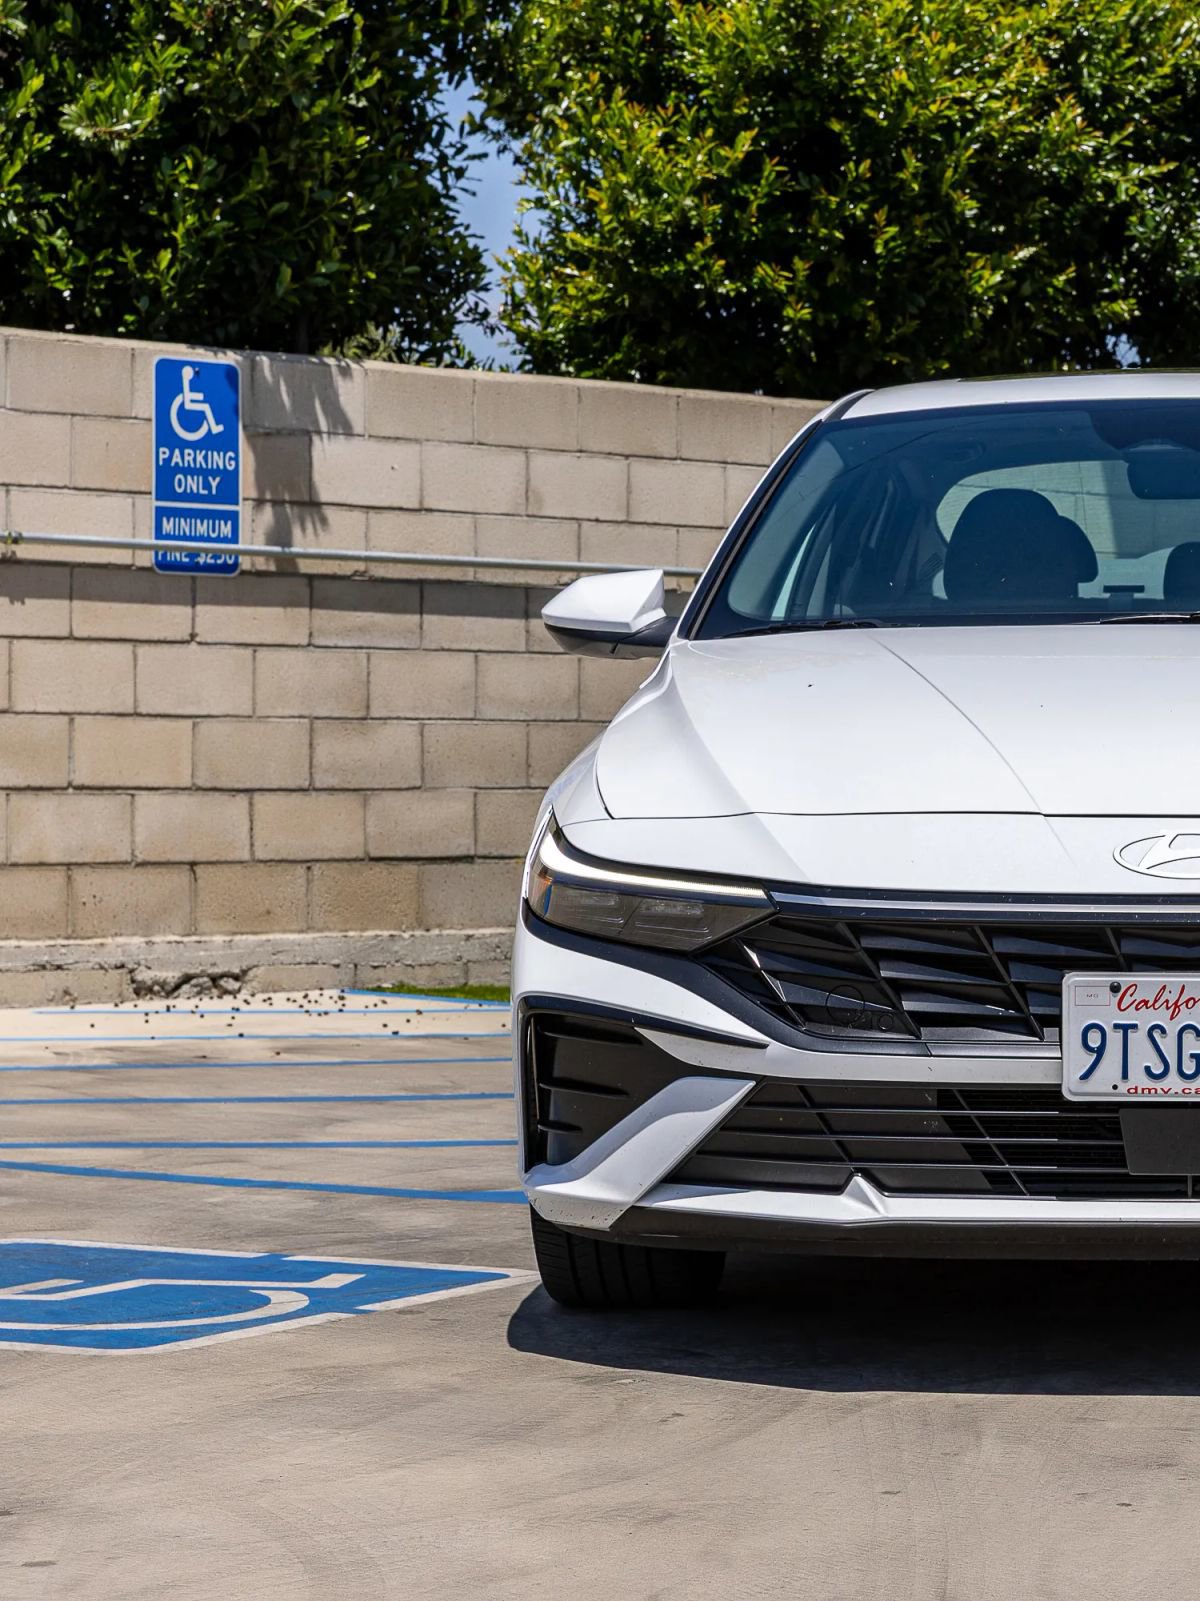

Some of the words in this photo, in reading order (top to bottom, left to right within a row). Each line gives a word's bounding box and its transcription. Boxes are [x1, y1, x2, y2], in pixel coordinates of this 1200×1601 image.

[158, 447, 236, 470] PARKING
[174, 474, 221, 494] ONLY
[162, 517, 232, 538] MINIMUM
